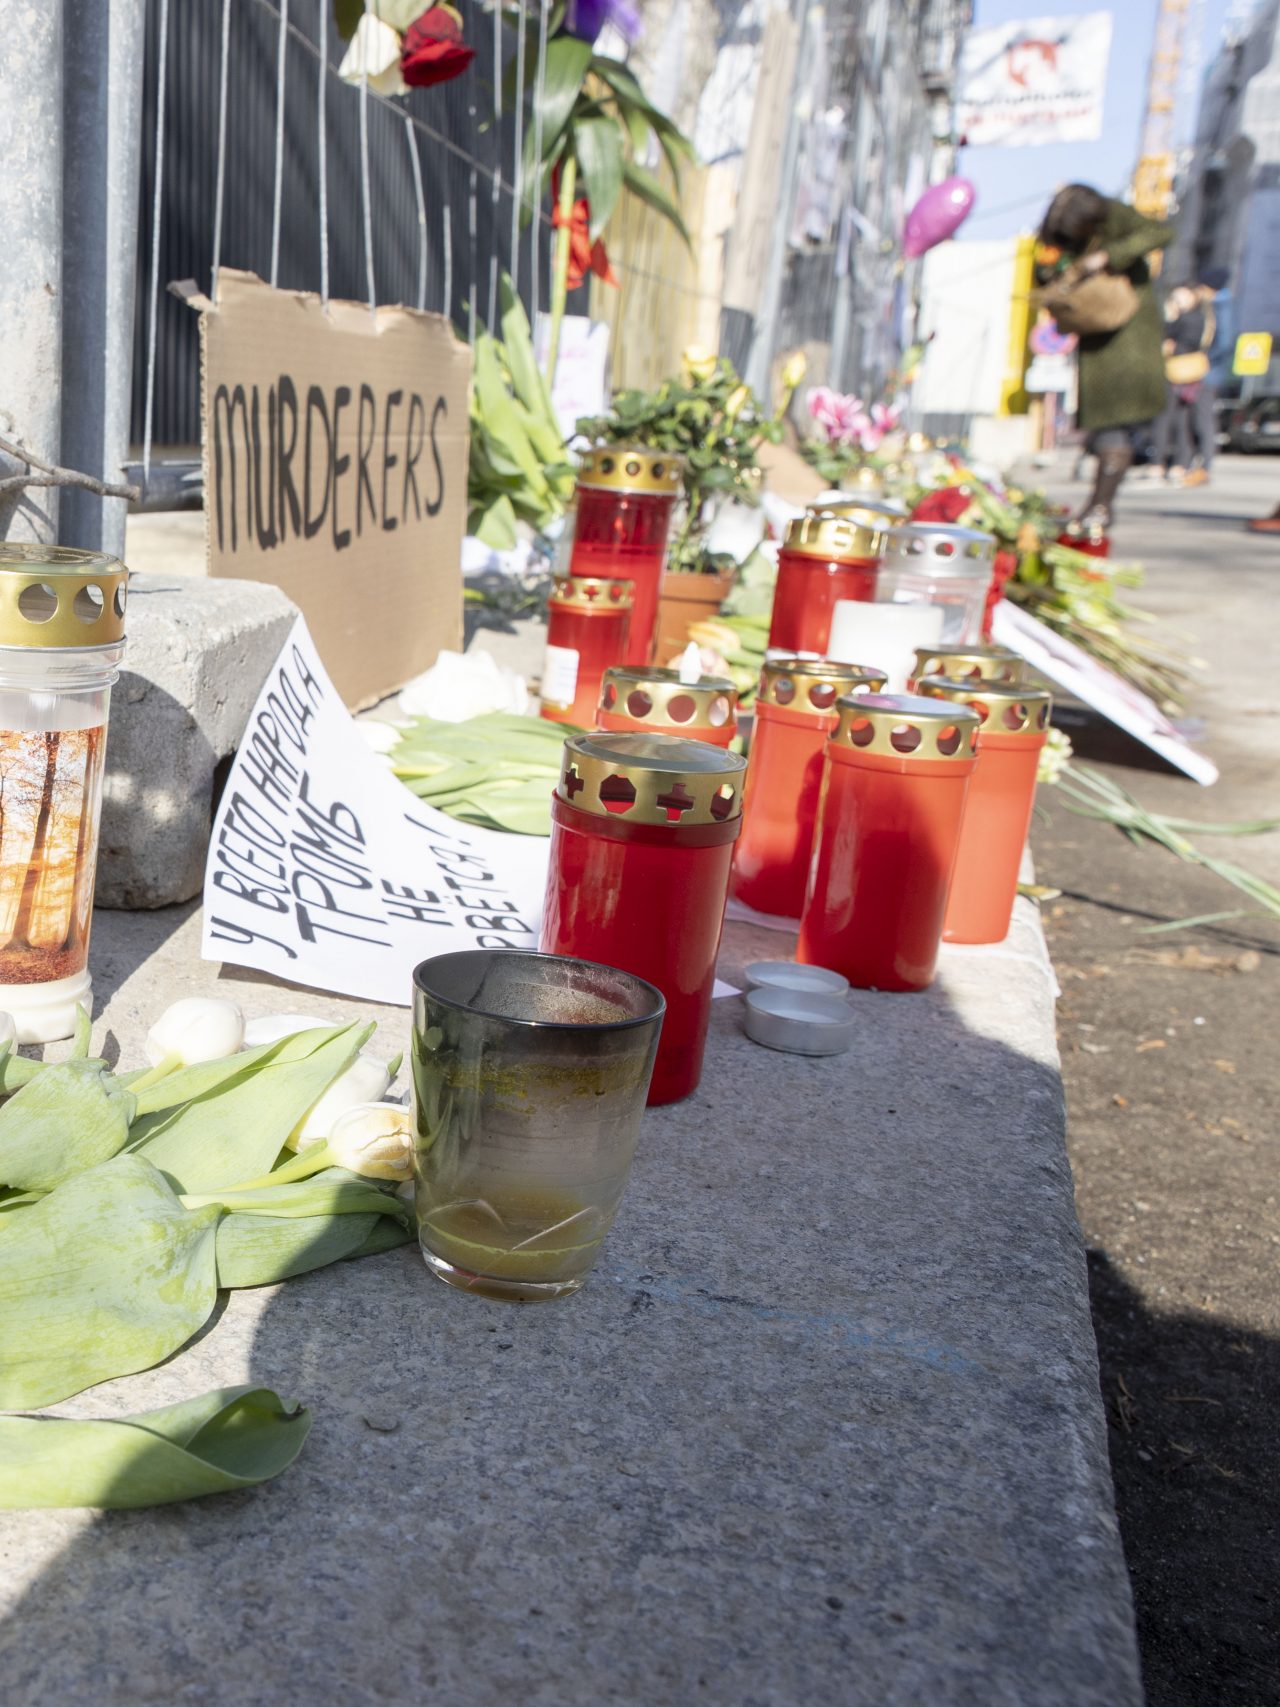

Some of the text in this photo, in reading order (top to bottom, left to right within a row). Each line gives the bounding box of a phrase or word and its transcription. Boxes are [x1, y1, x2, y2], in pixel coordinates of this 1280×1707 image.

[214, 374, 448, 553] MURDERERS
[209, 643, 324, 960] У ВСЕГО НАРОДА
[290, 772, 394, 948] ТРОМБ
[380, 878, 455, 927] НЕ
